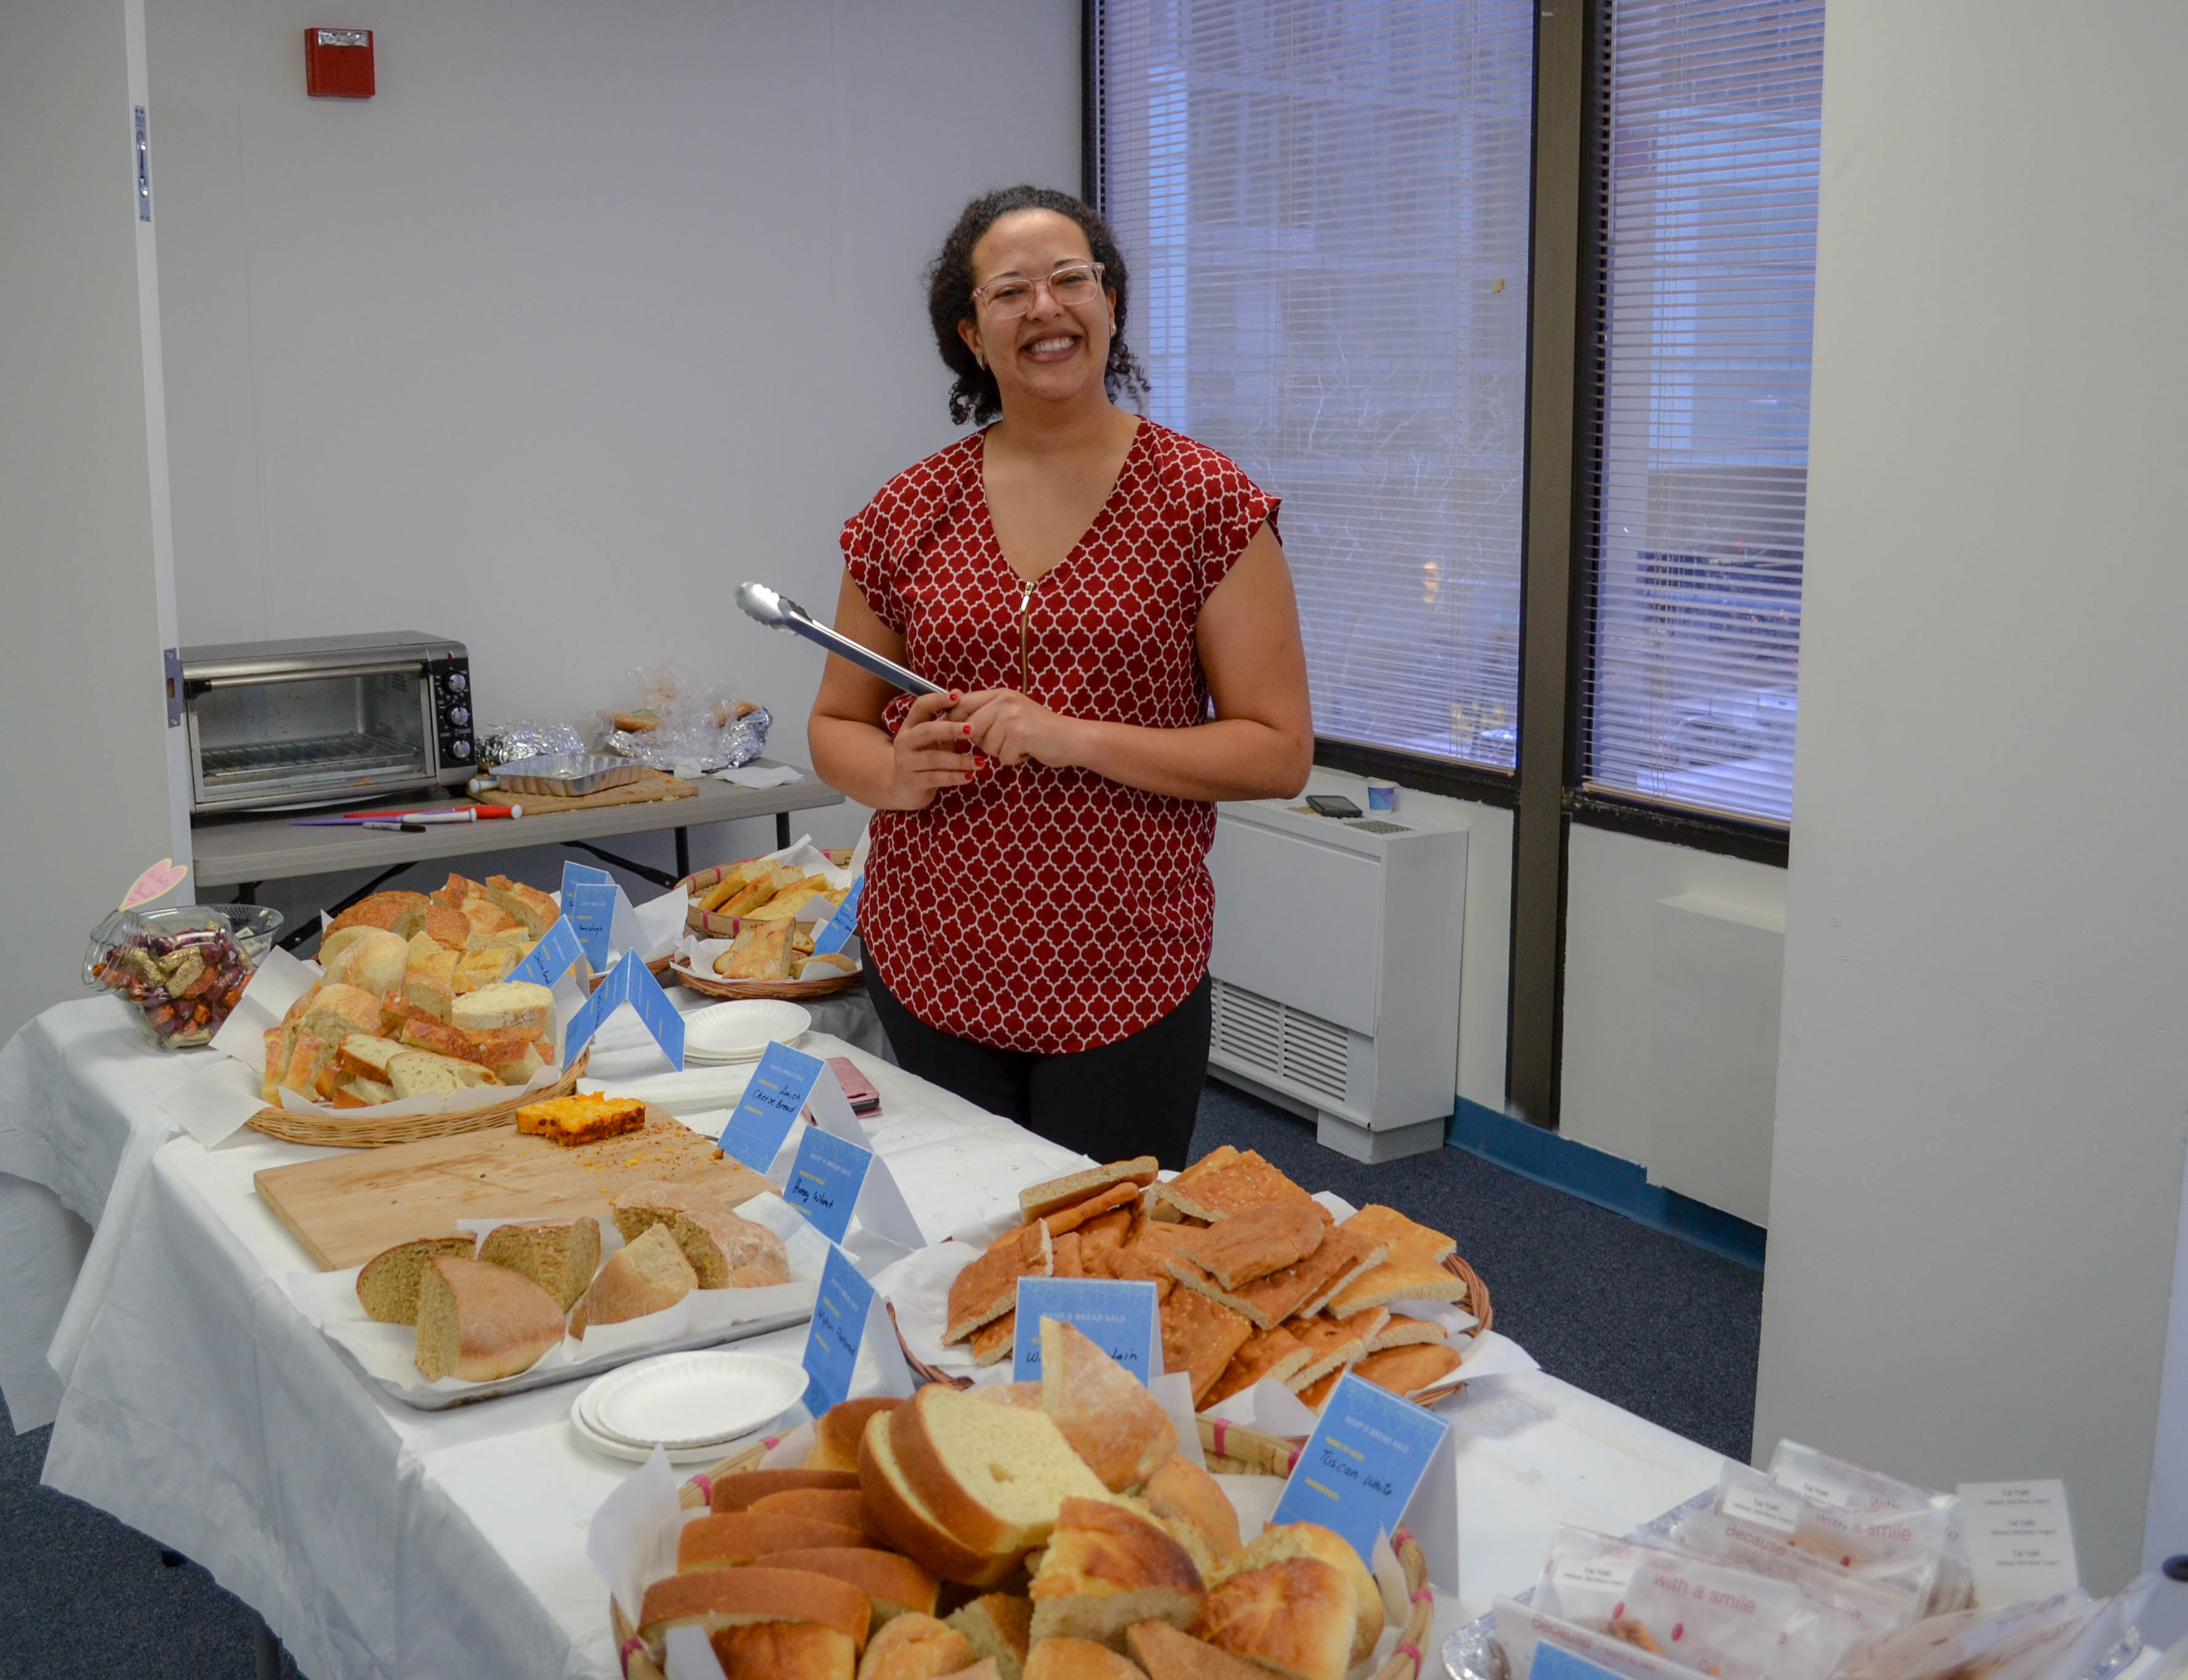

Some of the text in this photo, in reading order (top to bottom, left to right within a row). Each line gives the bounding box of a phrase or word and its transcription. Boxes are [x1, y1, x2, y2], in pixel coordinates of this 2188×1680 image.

[779, 1084, 801, 1101] Amish
[792, 1176, 810, 1204] Honey
[813, 1190, 834, 1210] Wheat
[1320, 1448, 1359, 1479] Tuscan
[1724, 1522, 1786, 1556] Because
[1867, 1522, 1912, 1542] smile
[1654, 1572, 1689, 1596] with
[1691, 1583, 1704, 1600] a
[1708, 1588, 1756, 1615] smile
